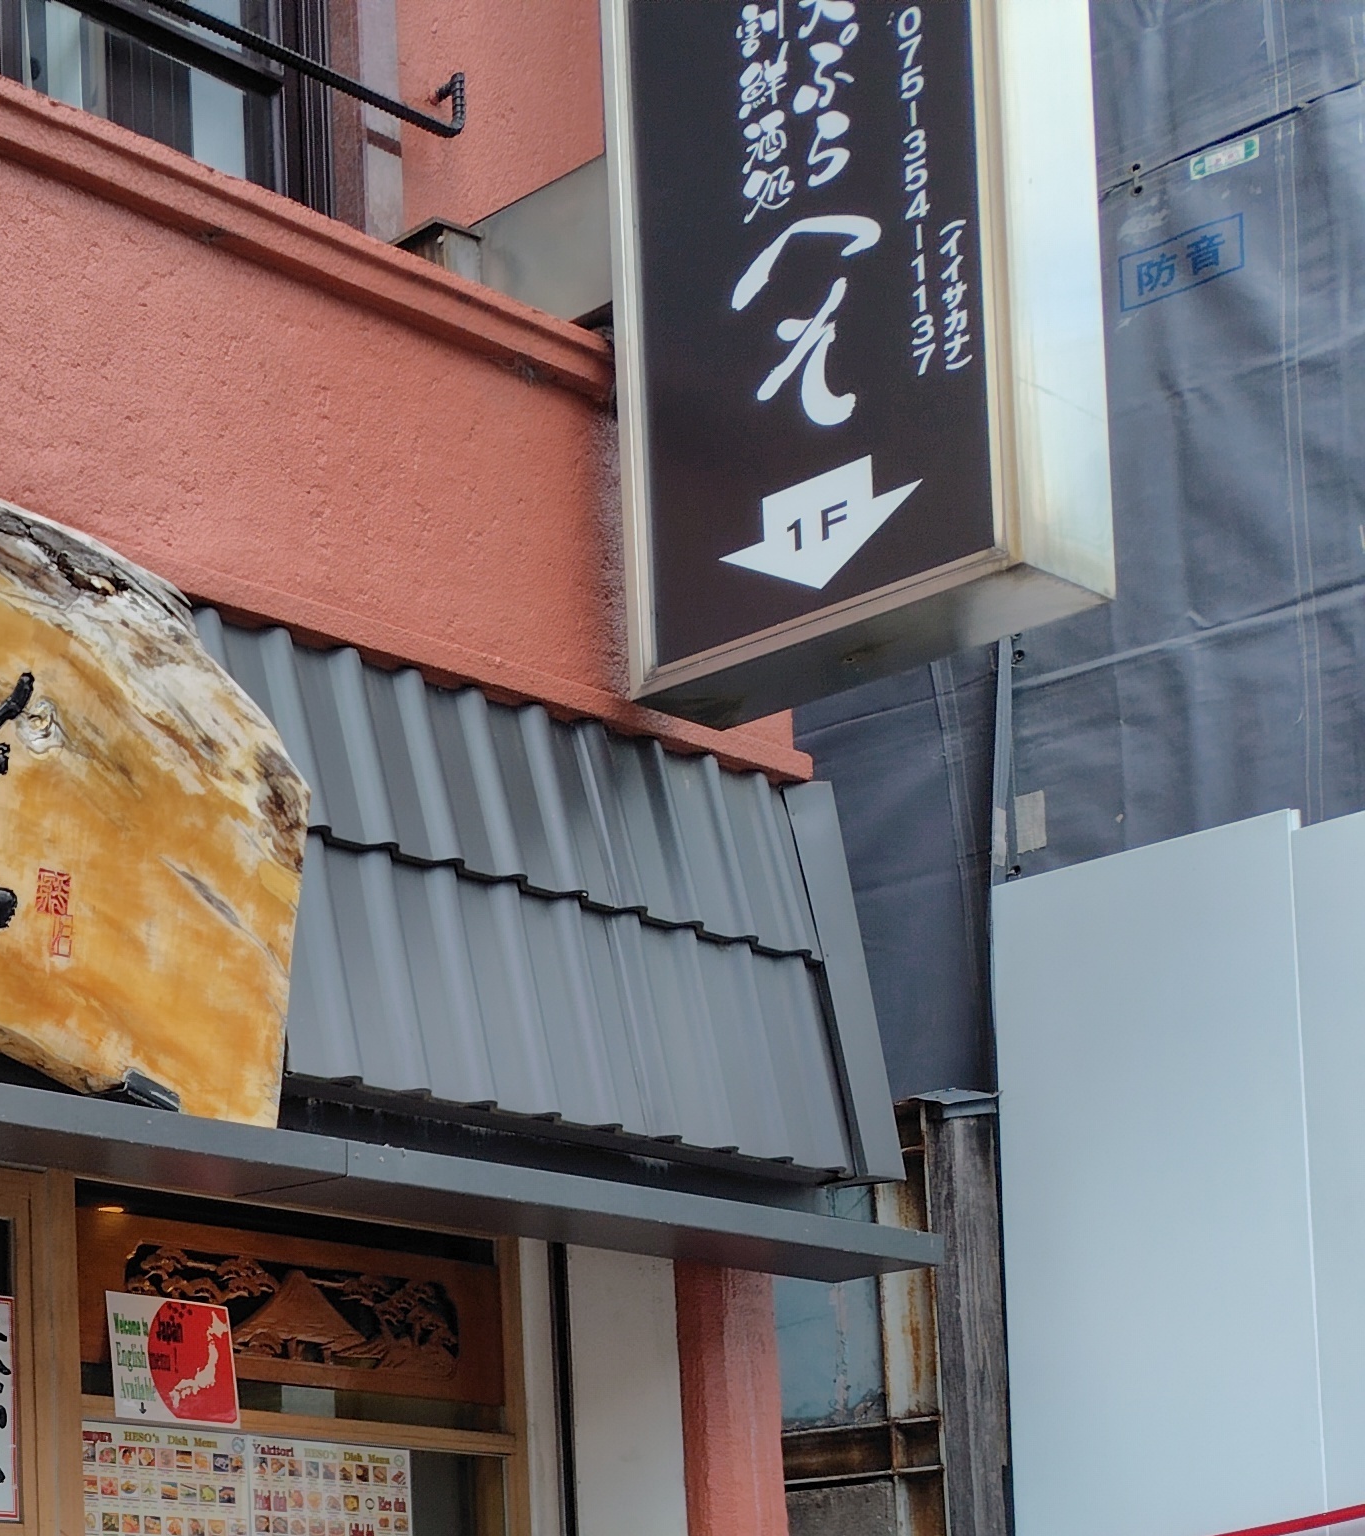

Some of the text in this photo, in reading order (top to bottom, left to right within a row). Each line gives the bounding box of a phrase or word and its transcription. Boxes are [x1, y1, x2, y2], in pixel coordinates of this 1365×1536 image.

[1135, 231, 1226, 295] 防音
[732, 214, 882, 425] へそ
[785, 499, 849, 552] 1F
